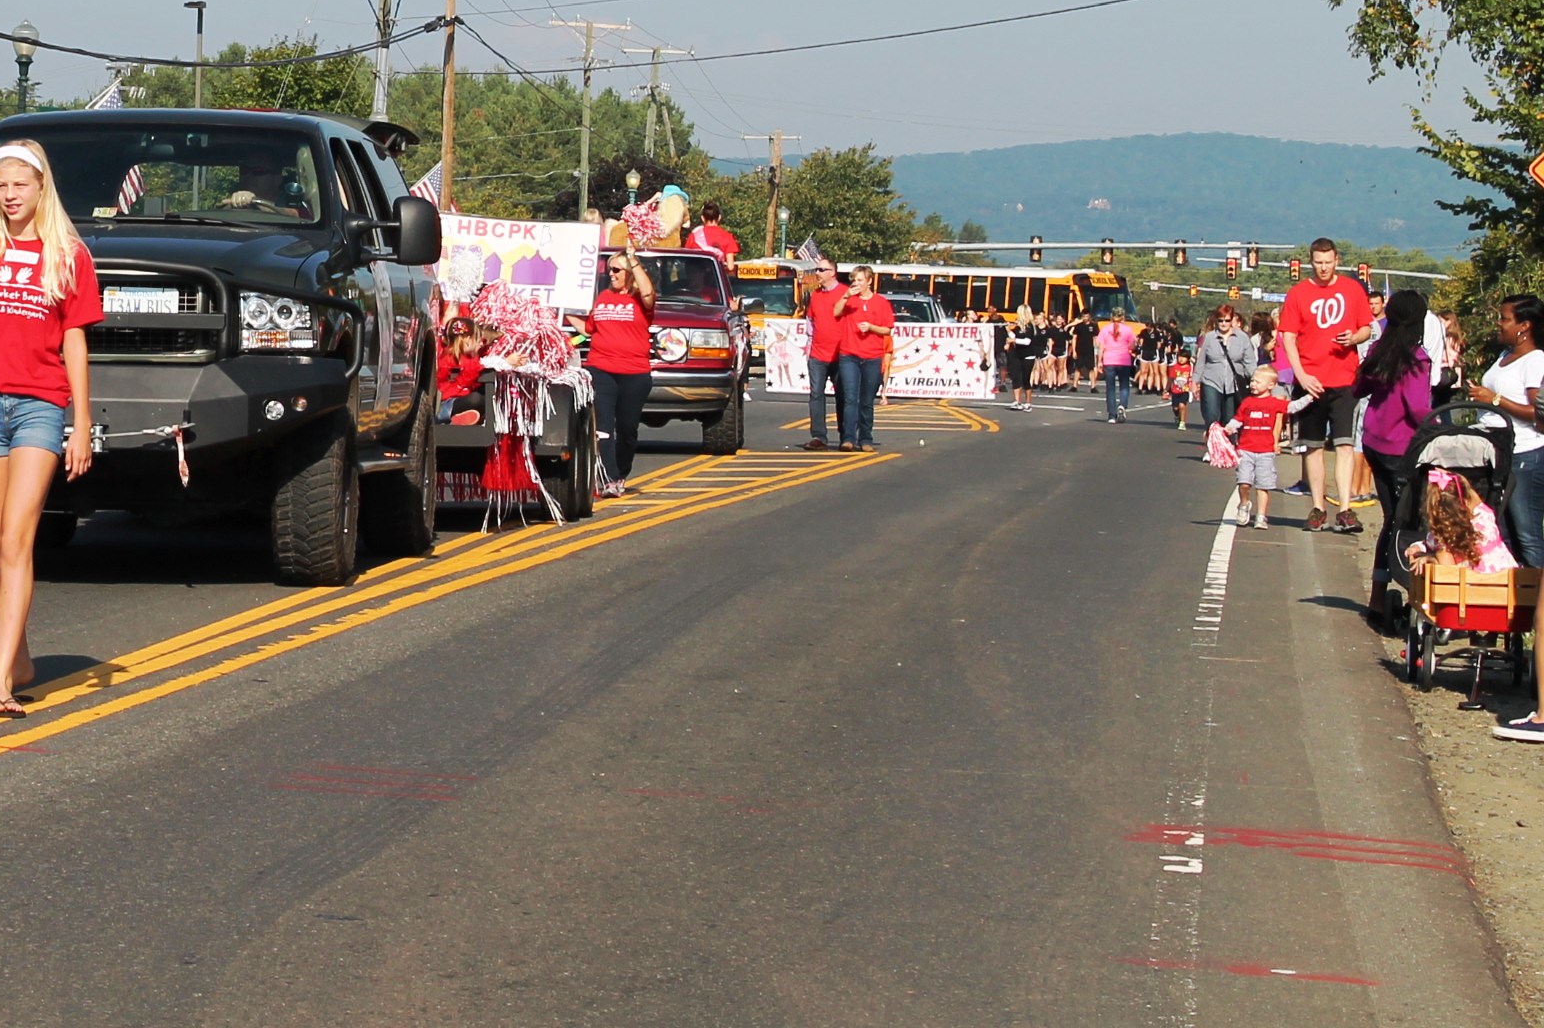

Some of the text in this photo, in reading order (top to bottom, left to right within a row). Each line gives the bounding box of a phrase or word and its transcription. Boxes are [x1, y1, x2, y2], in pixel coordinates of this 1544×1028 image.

[457, 219, 536, 240] HBCPK
[577, 244, 597, 290] 2014
[739, 267, 776, 276] SCHOOL BUS
[1310, 292, 1345, 329] W
[892, 325, 978, 339] ANCE CENTER
[904, 377, 961, 387] VIRGINIA
